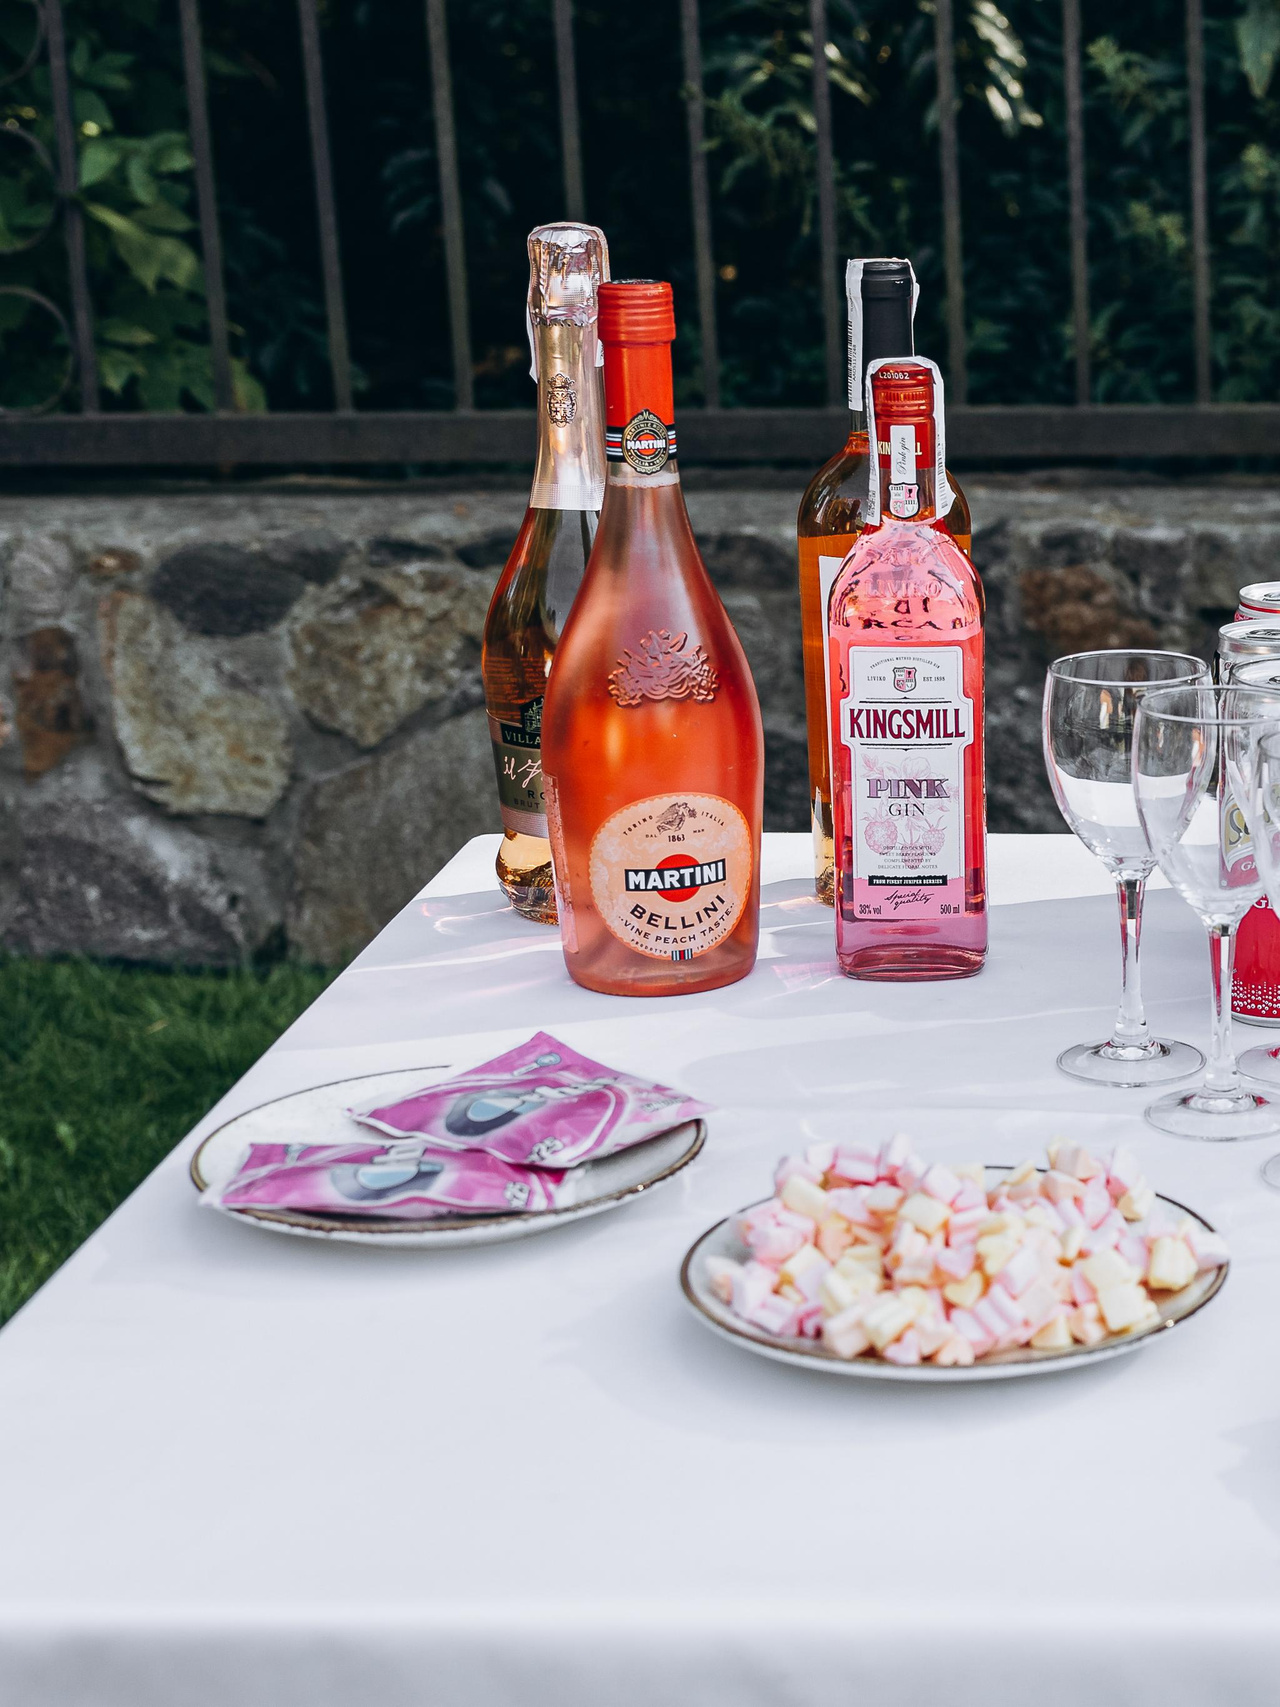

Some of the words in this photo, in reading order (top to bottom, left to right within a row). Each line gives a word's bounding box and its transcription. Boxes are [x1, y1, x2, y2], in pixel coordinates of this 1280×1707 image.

[626, 439, 666, 450] MARTINI
[849, 708, 966, 739] KINGSMILL
[867, 778, 951, 799] PINK
[514, 798, 540, 809] BRUT
[888, 803, 925, 816] GIN
[623, 815, 653, 836] TORINO
[701, 811, 726, 827] ITALIA
[668, 834, 686, 842] 1863
[627, 861, 724, 891] MARTINI
[884, 889, 921, 904] Special
[893, 893, 935, 911] quality
[630, 894, 726, 930] BELLINI
[859, 904, 872, 916] 38%
[873, 905, 882, 915] vol
[940, 904, 951, 915] 500
[952, 904, 960, 914] ml
[624, 921, 651, 940] VINE
[655, 934, 696, 945] PEACH
[700, 909, 731, 937] TASTE
[631, 938, 668, 955] PRODOTTO
